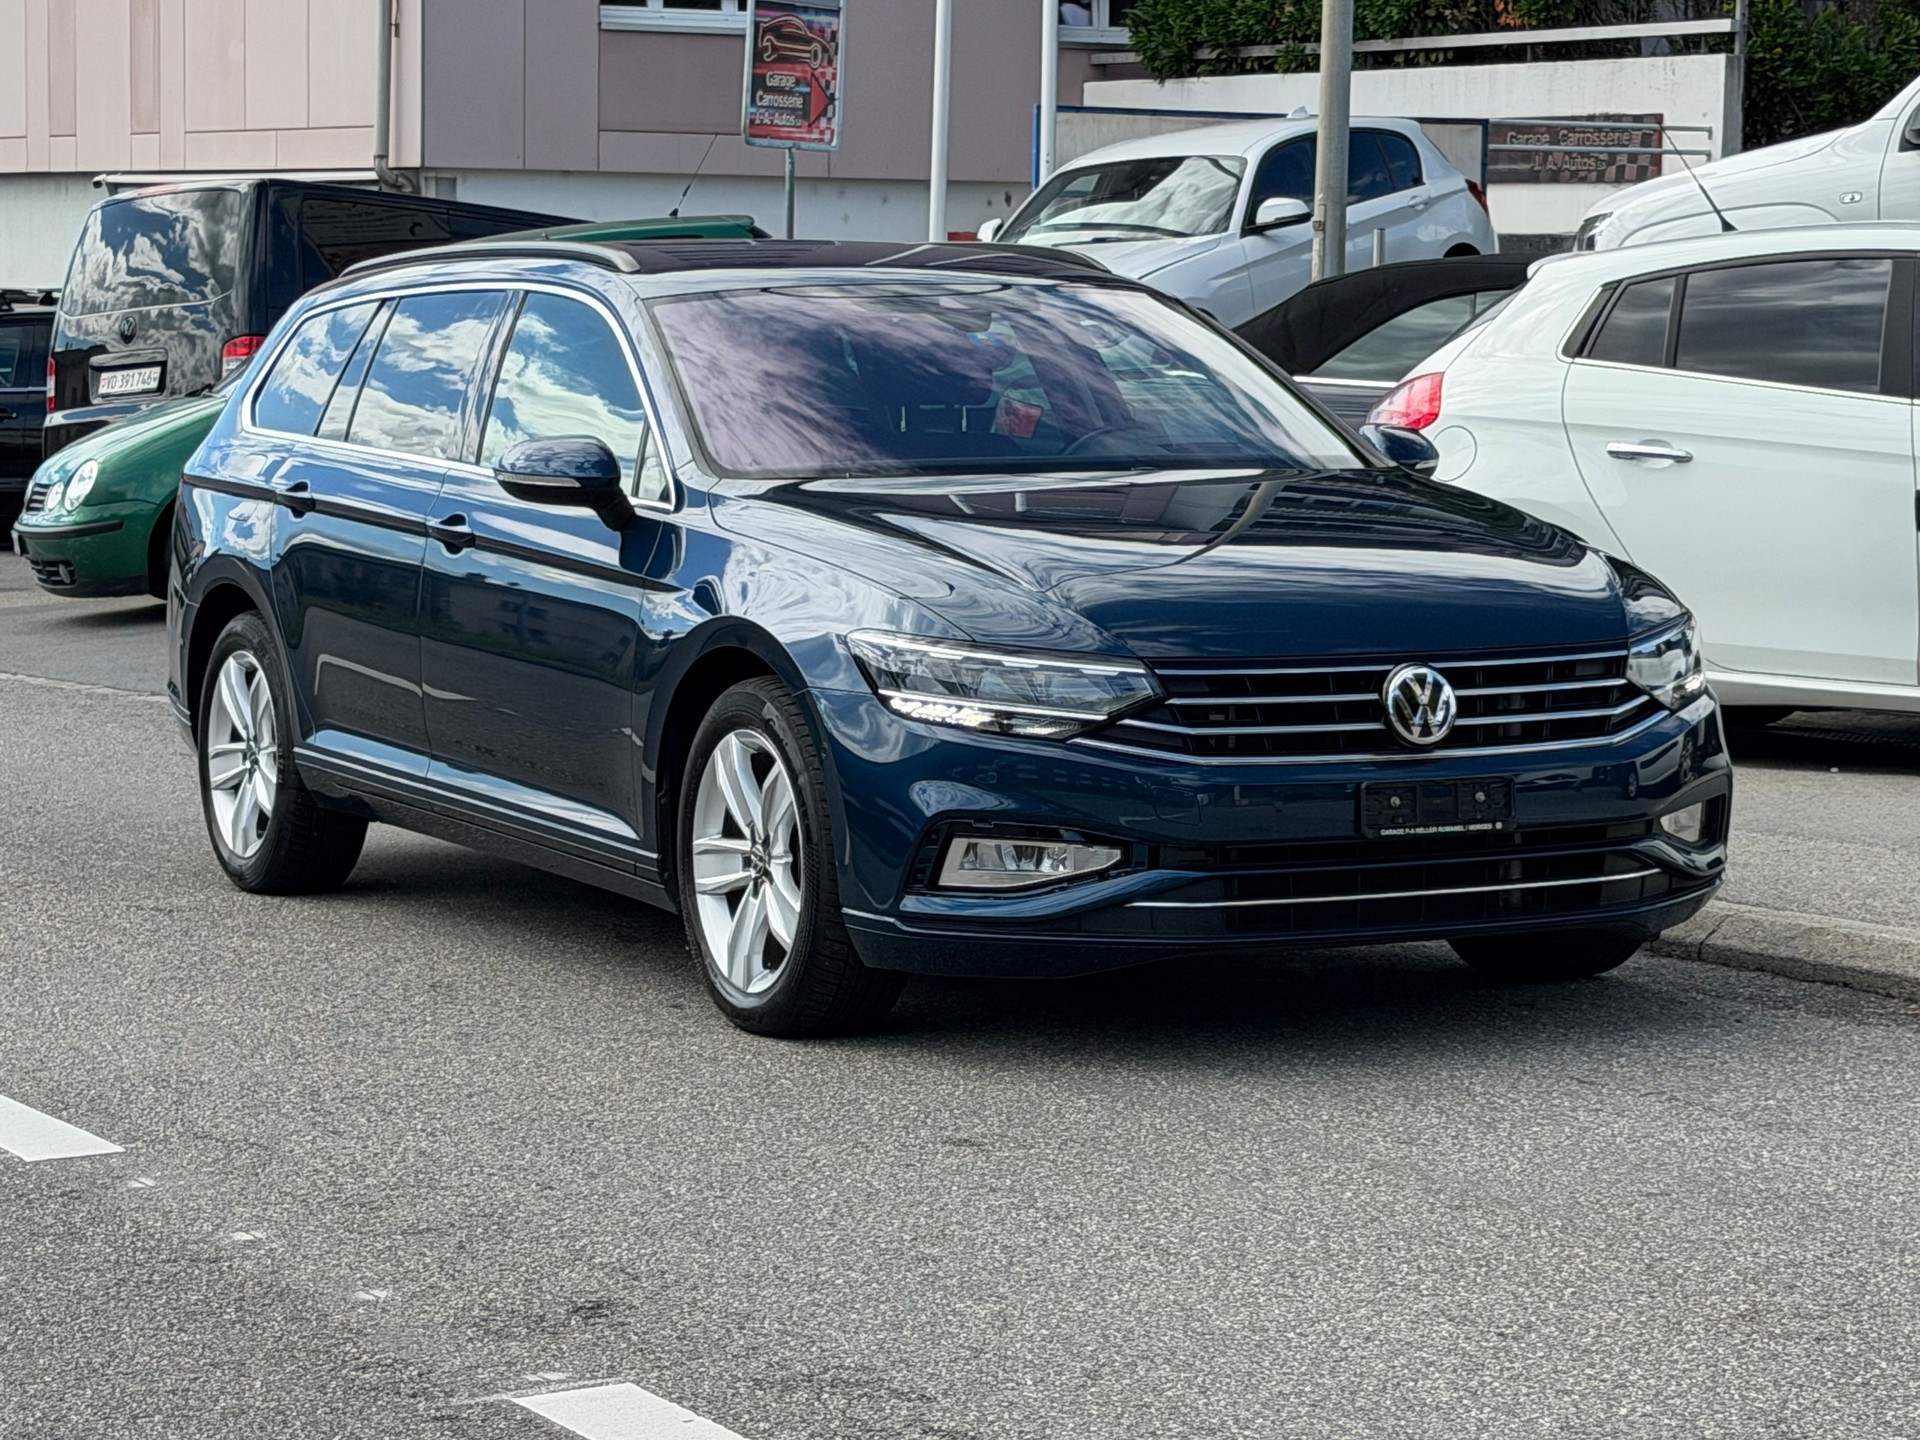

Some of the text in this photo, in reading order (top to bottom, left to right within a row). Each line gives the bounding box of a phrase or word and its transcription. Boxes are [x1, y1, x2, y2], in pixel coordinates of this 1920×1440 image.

[766, 71, 796, 90] Garage
[756, 90, 803, 108] Carrosserie
[1507, 130, 1630, 146] Garage Carrosserie
[1562, 154, 1596, 170] Autos
